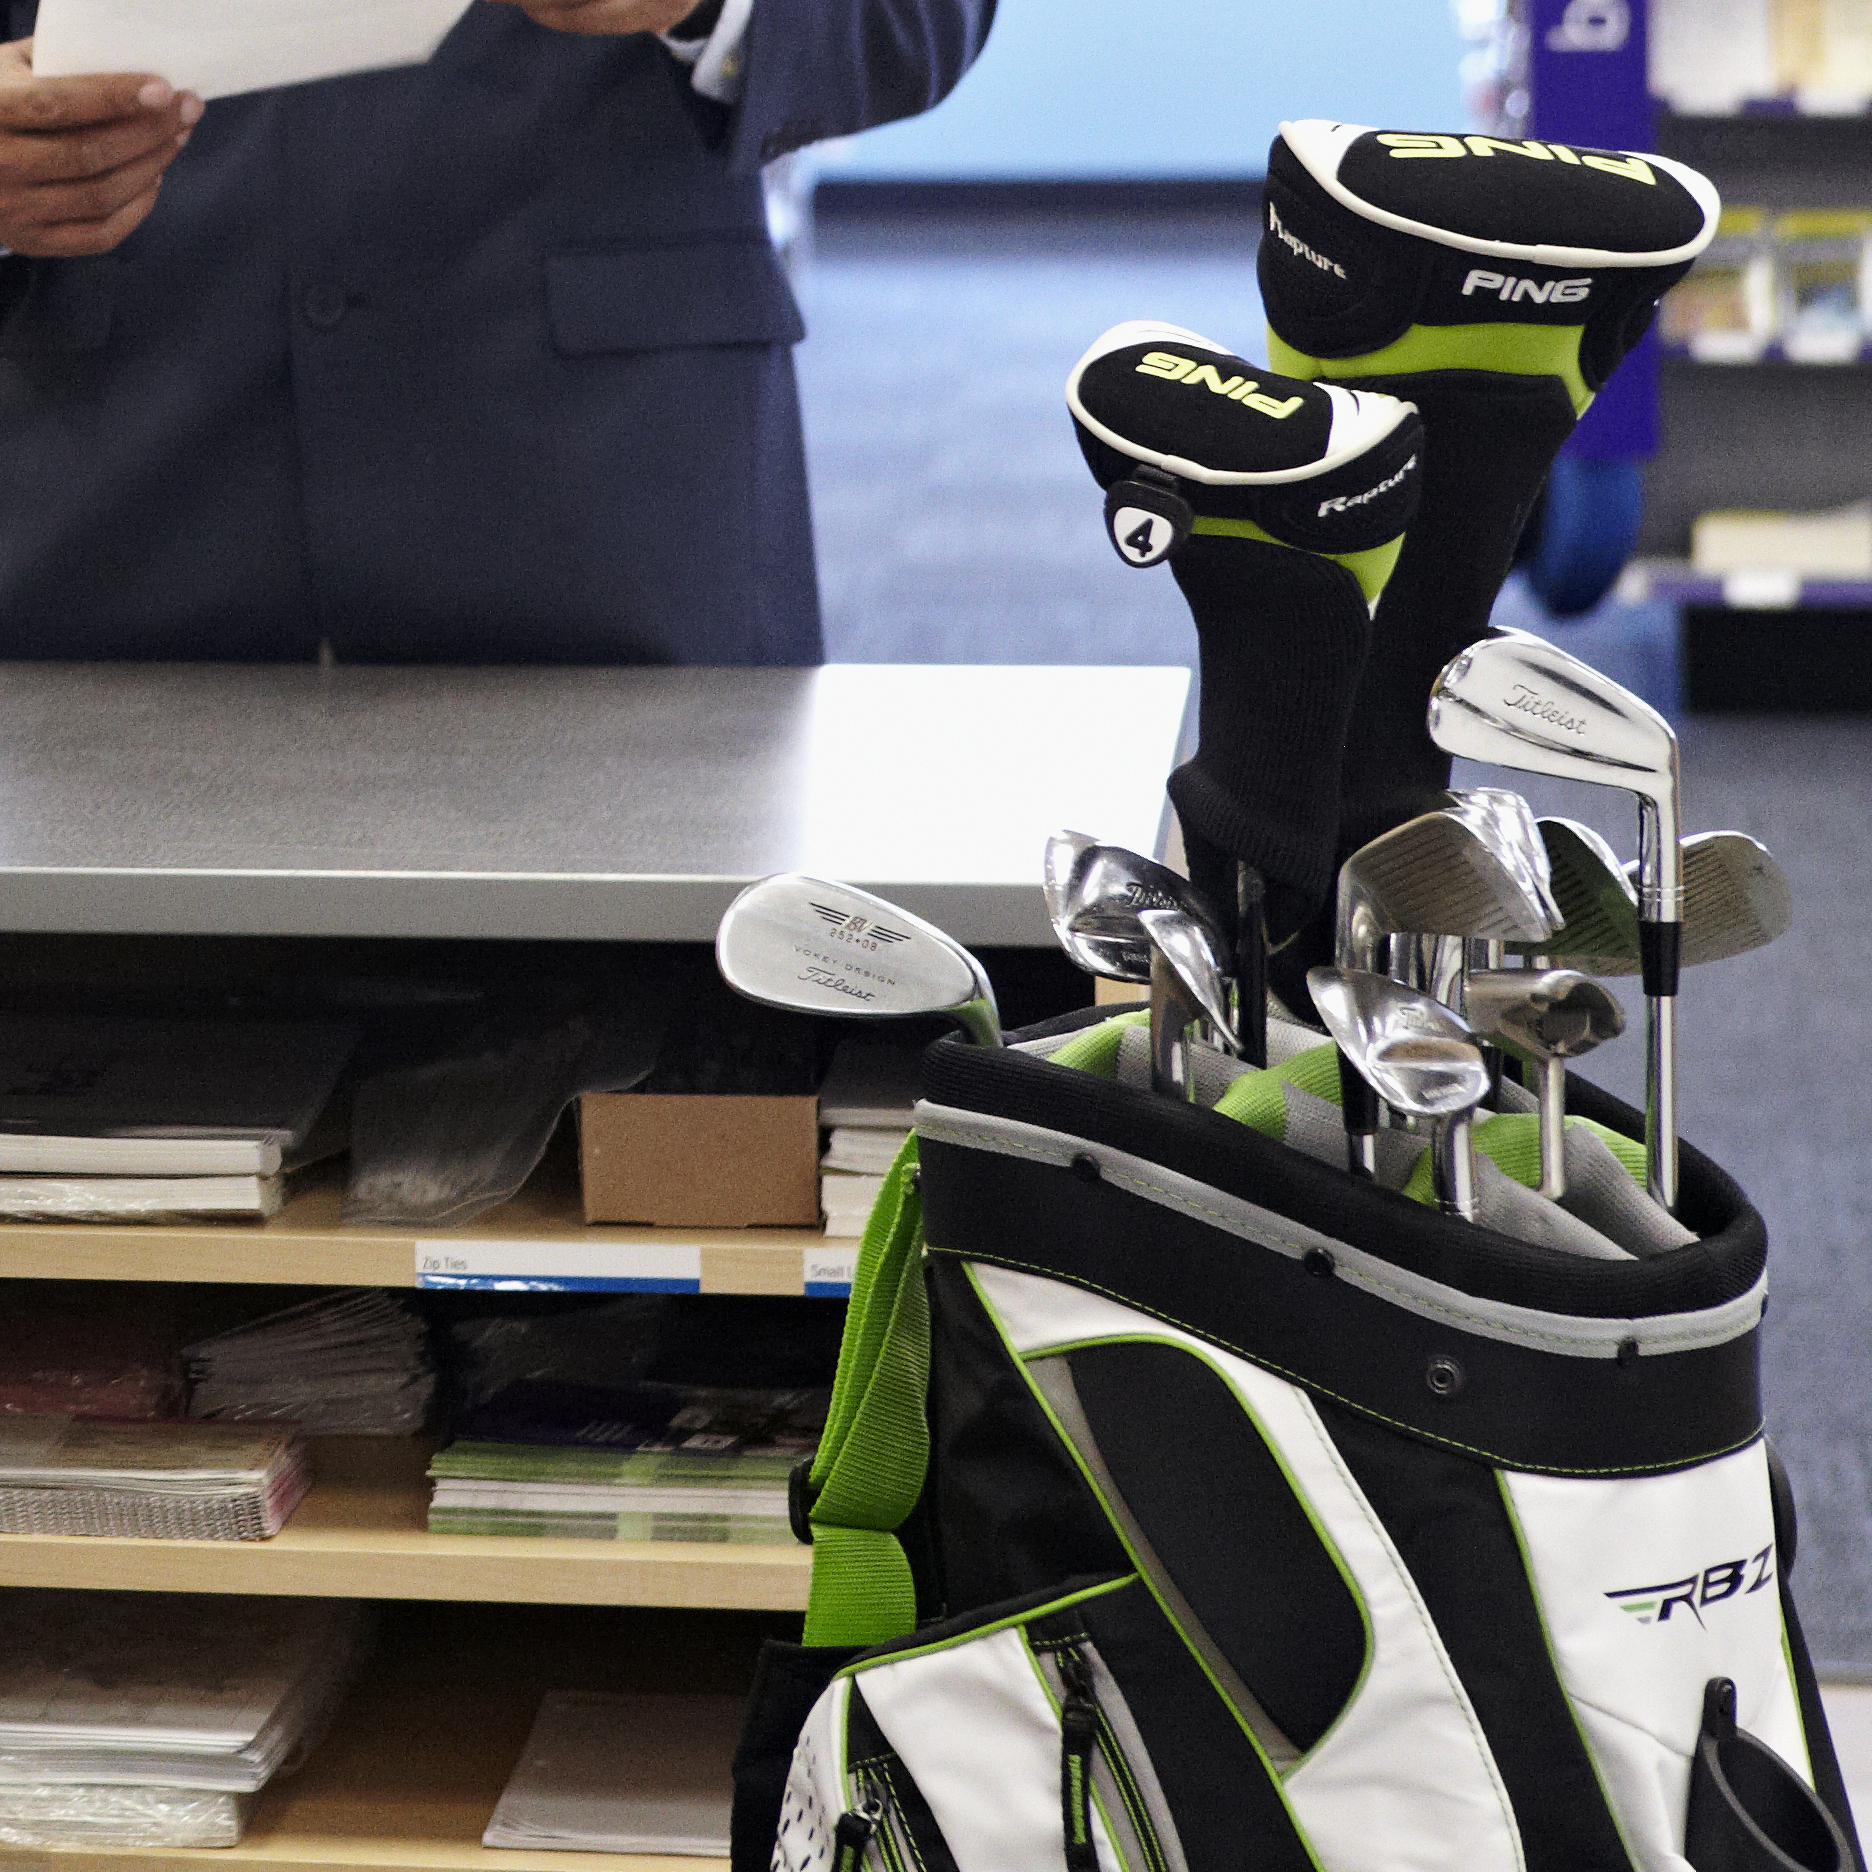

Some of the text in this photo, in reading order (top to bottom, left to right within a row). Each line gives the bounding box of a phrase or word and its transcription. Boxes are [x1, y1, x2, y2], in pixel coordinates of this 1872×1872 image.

[1376, 132, 1657, 186] PING
[1461, 268, 1593, 304] PING
[1134, 350, 1304, 420] PING
[1124, 517, 1154, 558] 4
[1503, 683, 1587, 735] Titleist
[794, 944, 896, 986] VOKEY DESIGN
[797, 966, 876, 1002] Titleist
[422, 1256, 467, 1270] Zip Ties
